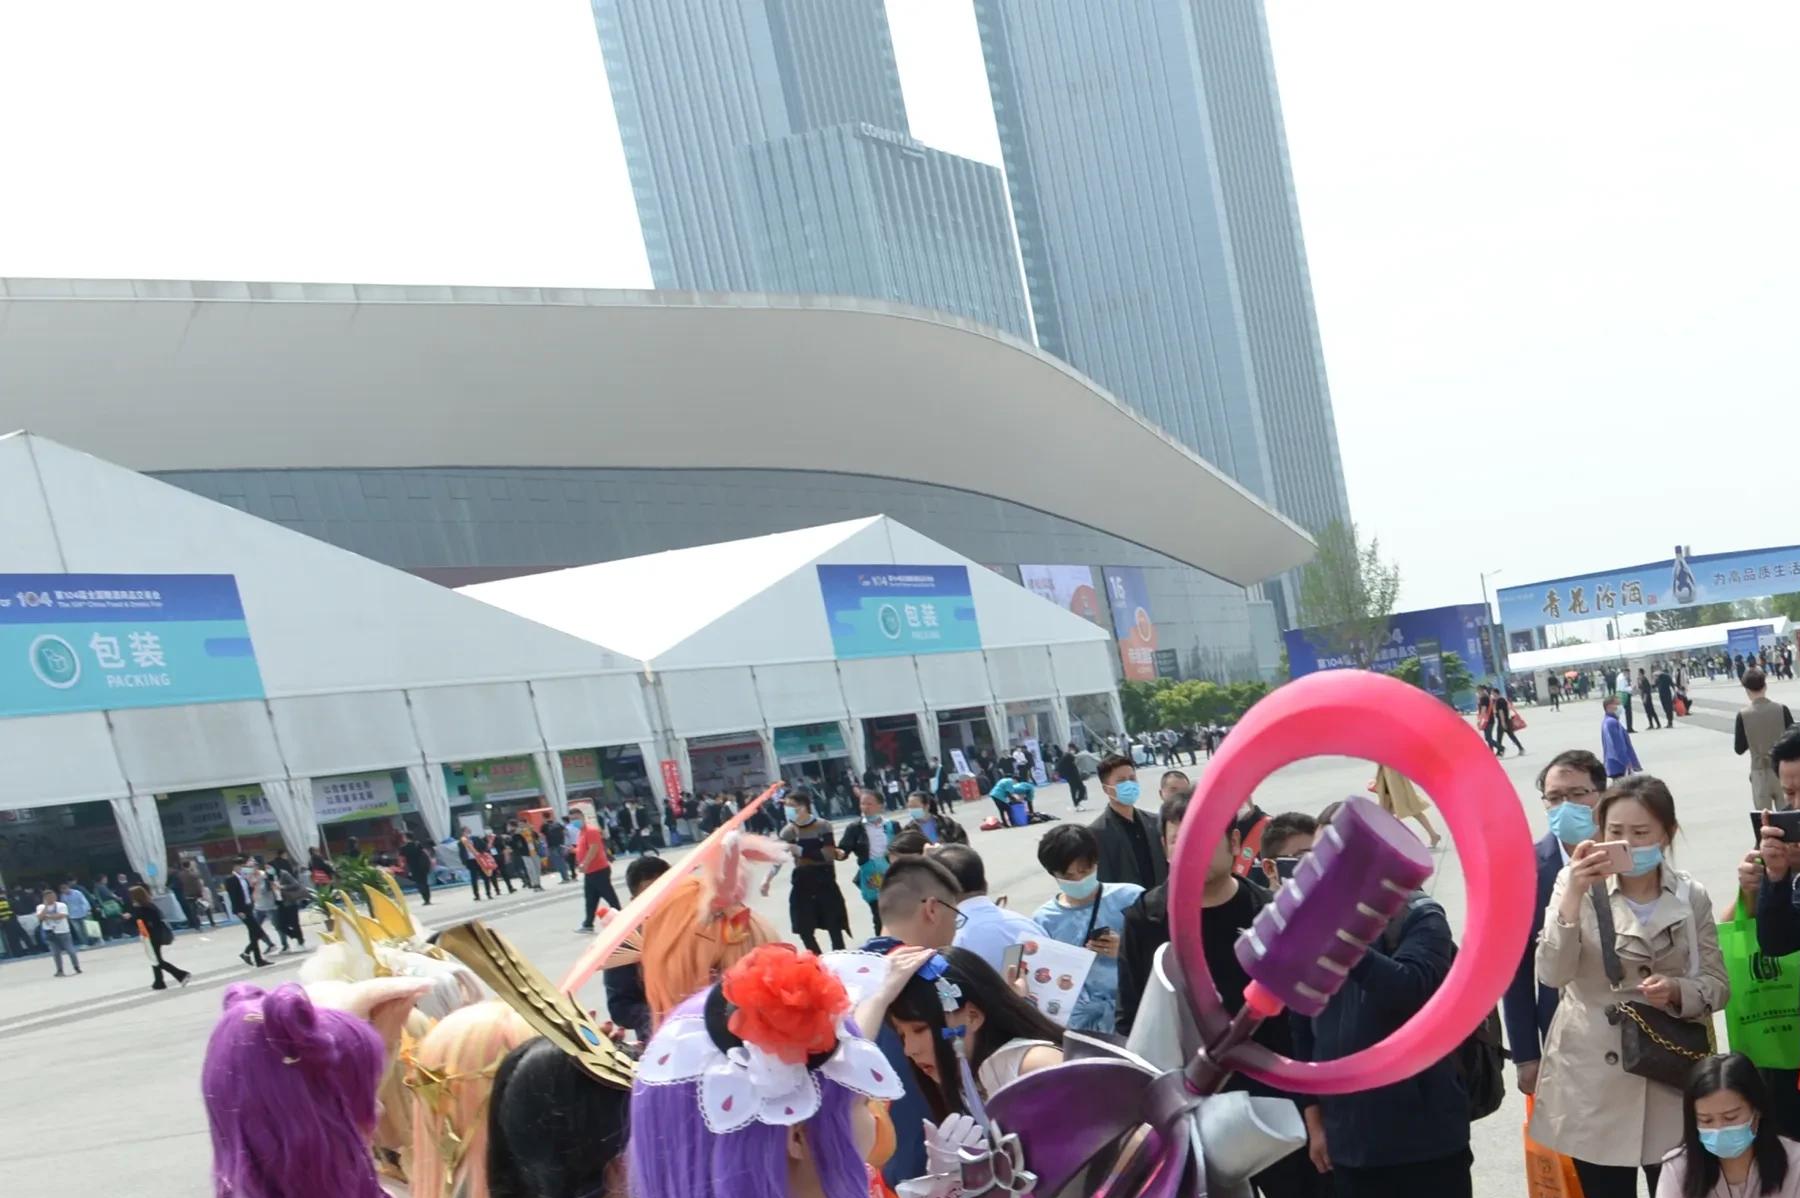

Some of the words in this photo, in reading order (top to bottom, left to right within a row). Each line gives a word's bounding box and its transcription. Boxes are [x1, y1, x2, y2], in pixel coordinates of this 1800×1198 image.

[1542, 580, 1643, 618] 青花汾酒
[904, 603, 939, 627] 包装
[89, 631, 167, 669] 包装
[107, 673, 171, 687] PACKING
